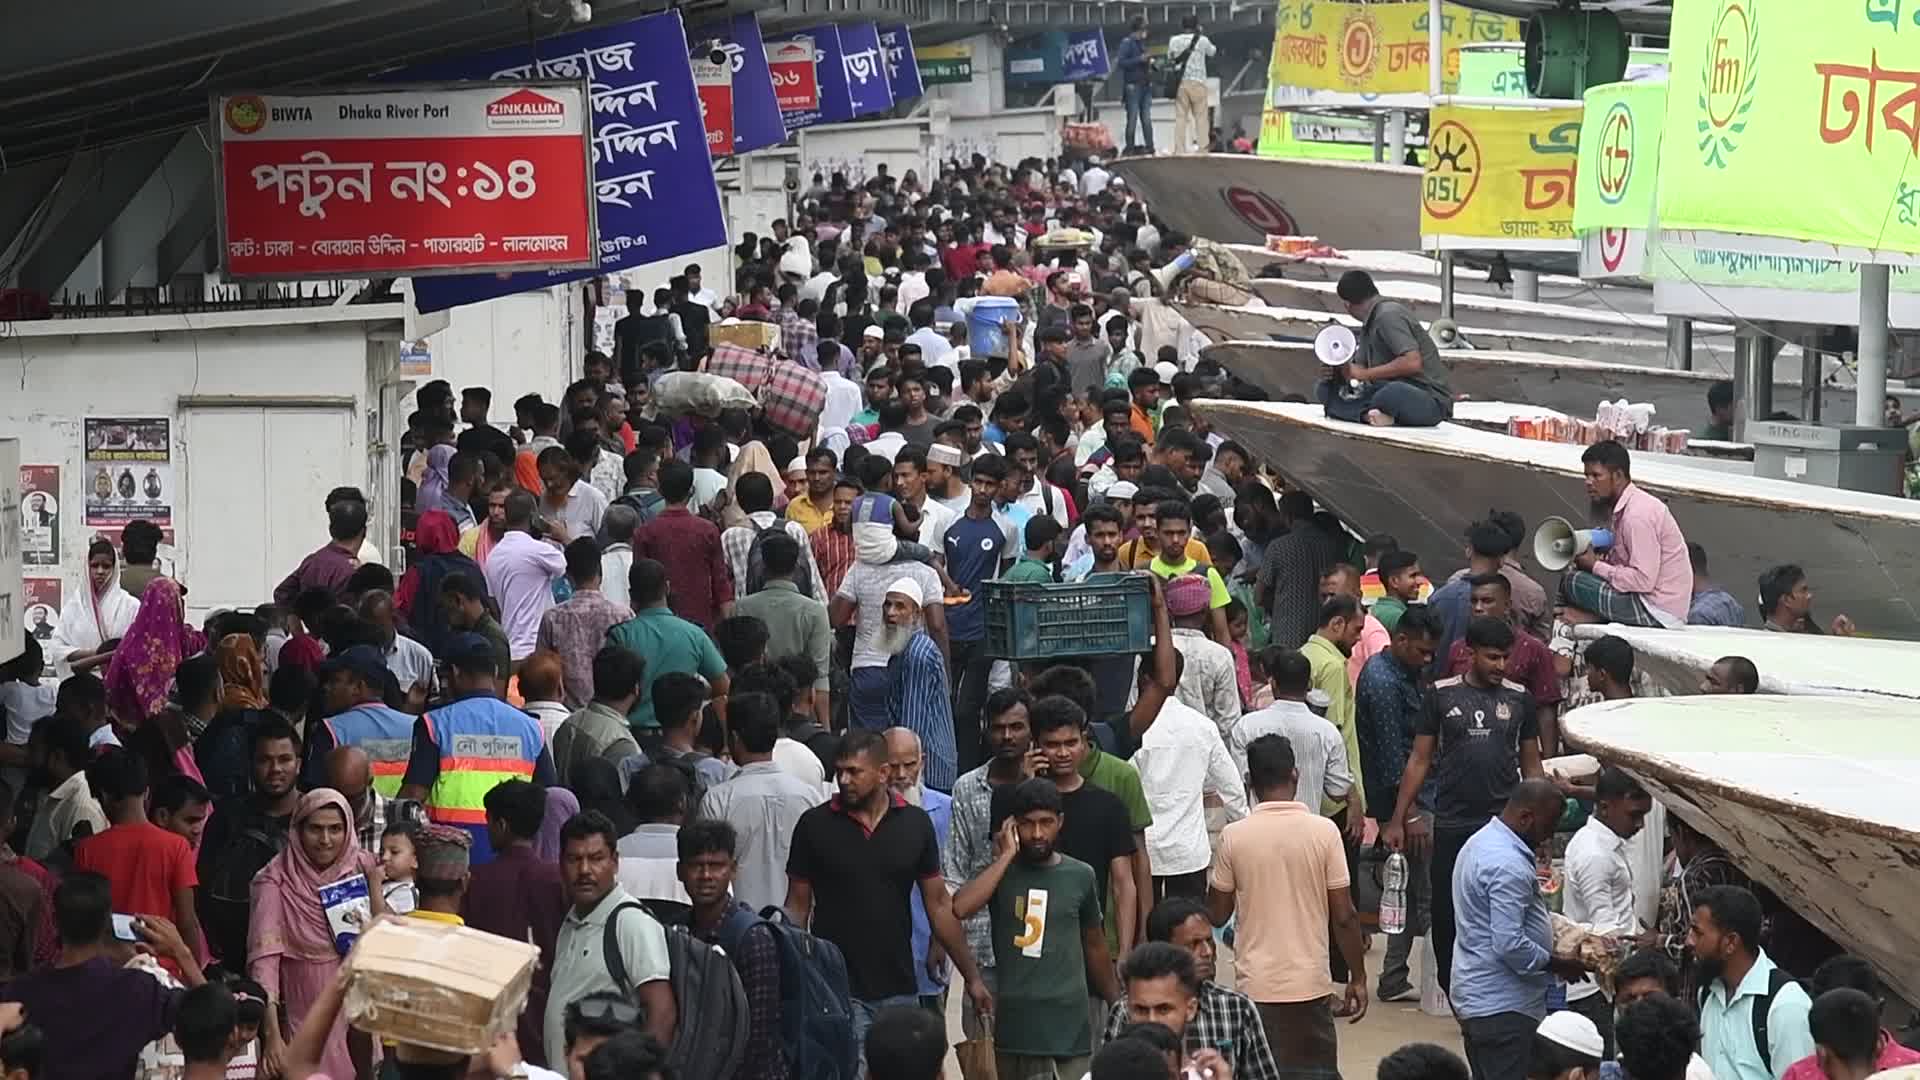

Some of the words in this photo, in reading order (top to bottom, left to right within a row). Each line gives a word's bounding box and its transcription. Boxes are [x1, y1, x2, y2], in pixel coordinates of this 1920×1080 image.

[1385, 37, 1431, 72] ঢাক
[272, 107, 312, 121] BIWTA
[339, 104, 382, 120] Dhaka
[386, 103, 419, 119] River
[424, 103, 449, 119] Port
[490, 103, 560, 115] ZINKALUM
[590, 81, 660, 118] দ্দিন
[1814, 47, 1920, 159] ঢাক
[1529, 122, 1581, 153] এ
[251, 150, 374, 219] পন্টুন
[1426, 176, 1462, 203] ASL
[1518, 159, 1578, 210] ঢা
[264, 240, 294, 257] ঢাকা
[312, 239, 365, 256] বোরহান
[368, 233, 406, 256] উদ্দিন
[423, 233, 486, 254] পাতারহাট
[502, 235, 568, 252] লালমোহন
